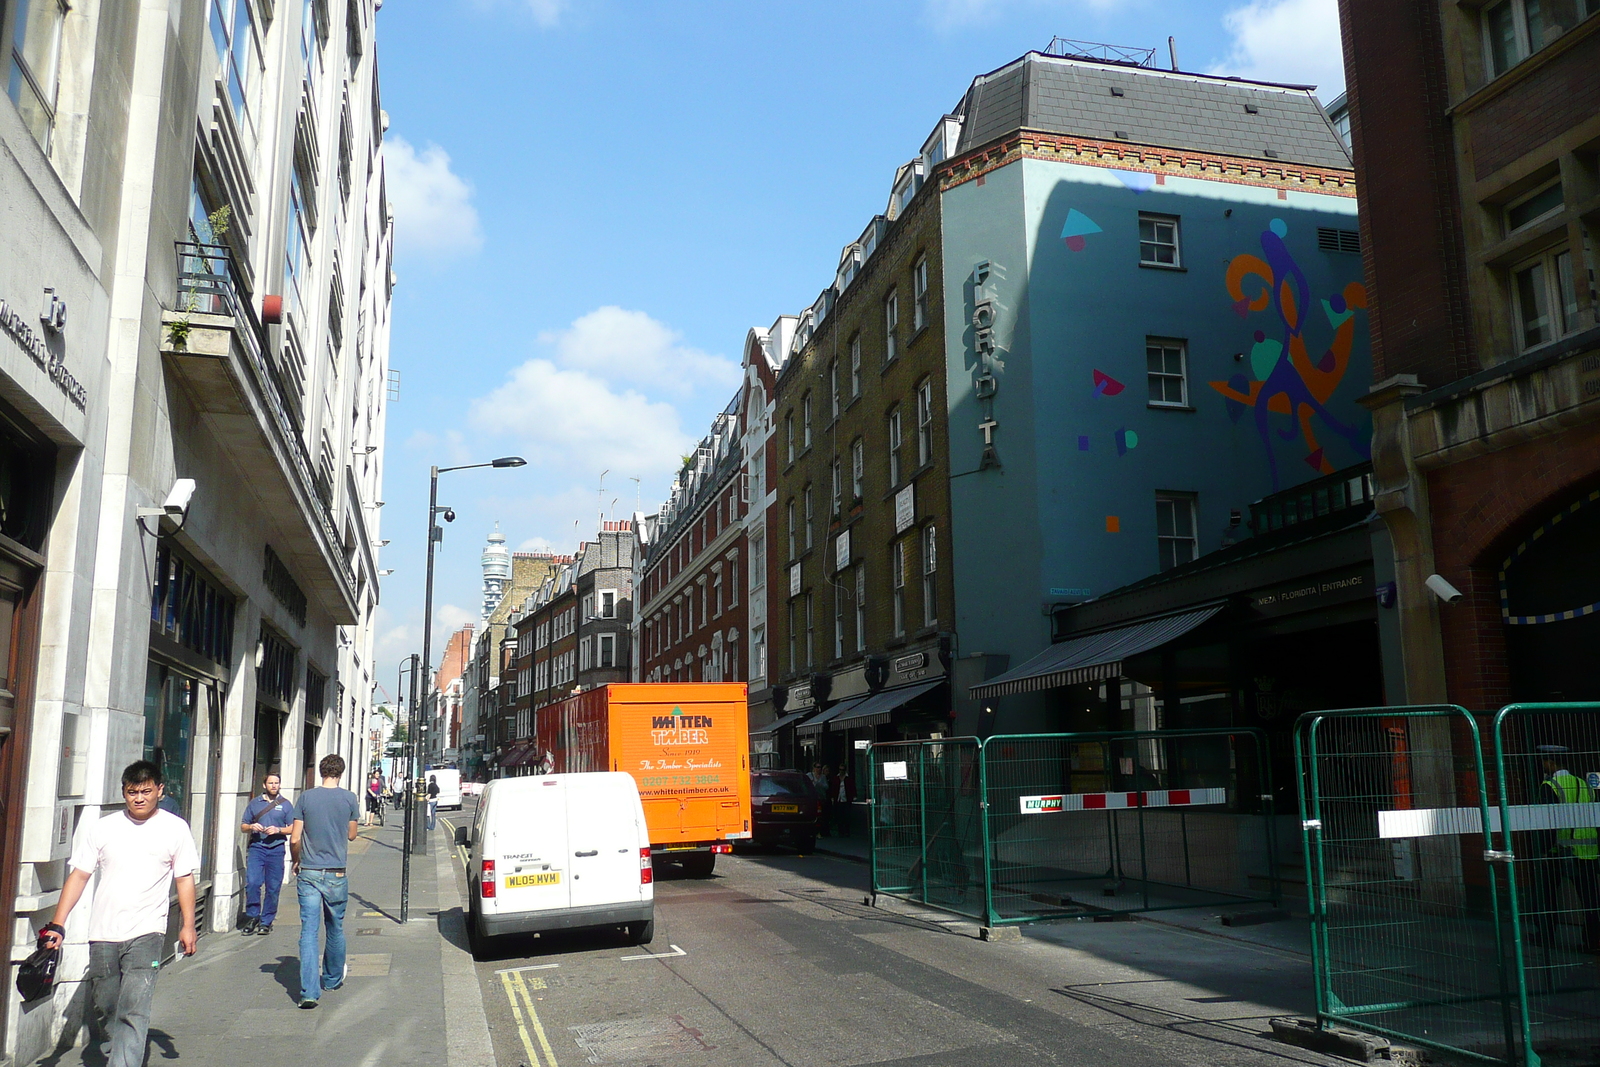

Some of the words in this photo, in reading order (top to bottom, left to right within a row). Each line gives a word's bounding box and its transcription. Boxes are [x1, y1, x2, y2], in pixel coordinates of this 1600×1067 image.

[972, 259, 1001, 470] FLORIDITA
[1258, 595, 1277, 606] MEZA
[1281, 586, 1317, 601] FLORIDITA
[1322, 576, 1363, 592] ENTRANCE
[652, 715, 712, 728] WHITTEN
[651, 729, 708, 745] TIMBER
[659, 747, 681, 757] Since
[639, 760, 654, 771] The
[656, 759, 682, 770] Timber
[684, 758, 721, 770] Specialists
[642, 776, 668, 786] 0207
[672, 776, 691, 785] 732
[1027, 799, 1061, 809] MURPHY
[509, 875, 535, 886] WL05
[537, 873, 556, 884] MVM
